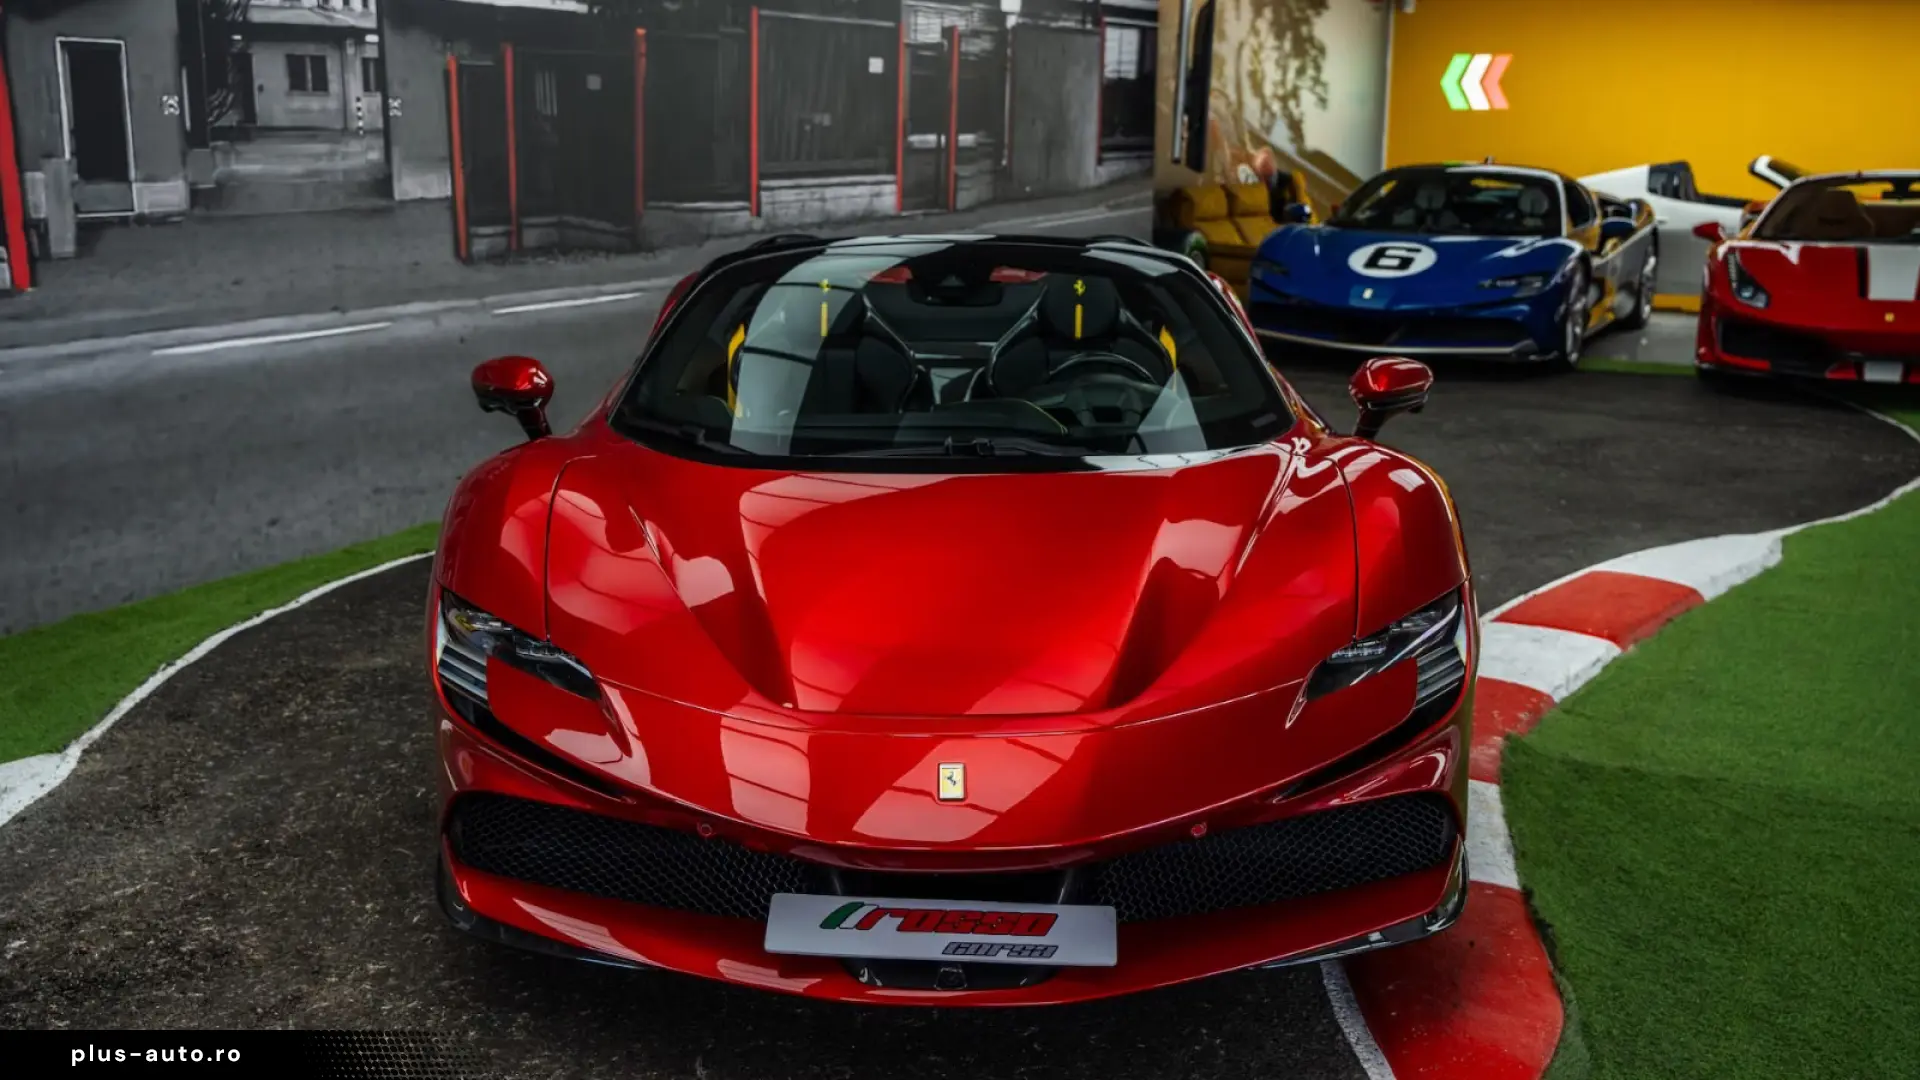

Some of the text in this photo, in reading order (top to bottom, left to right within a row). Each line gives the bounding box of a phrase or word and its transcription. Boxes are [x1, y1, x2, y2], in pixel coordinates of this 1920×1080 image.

[1363, 246, 1422, 270] 6
[856, 905, 1058, 936] rosso
[942, 943, 1058, 958] corsa
